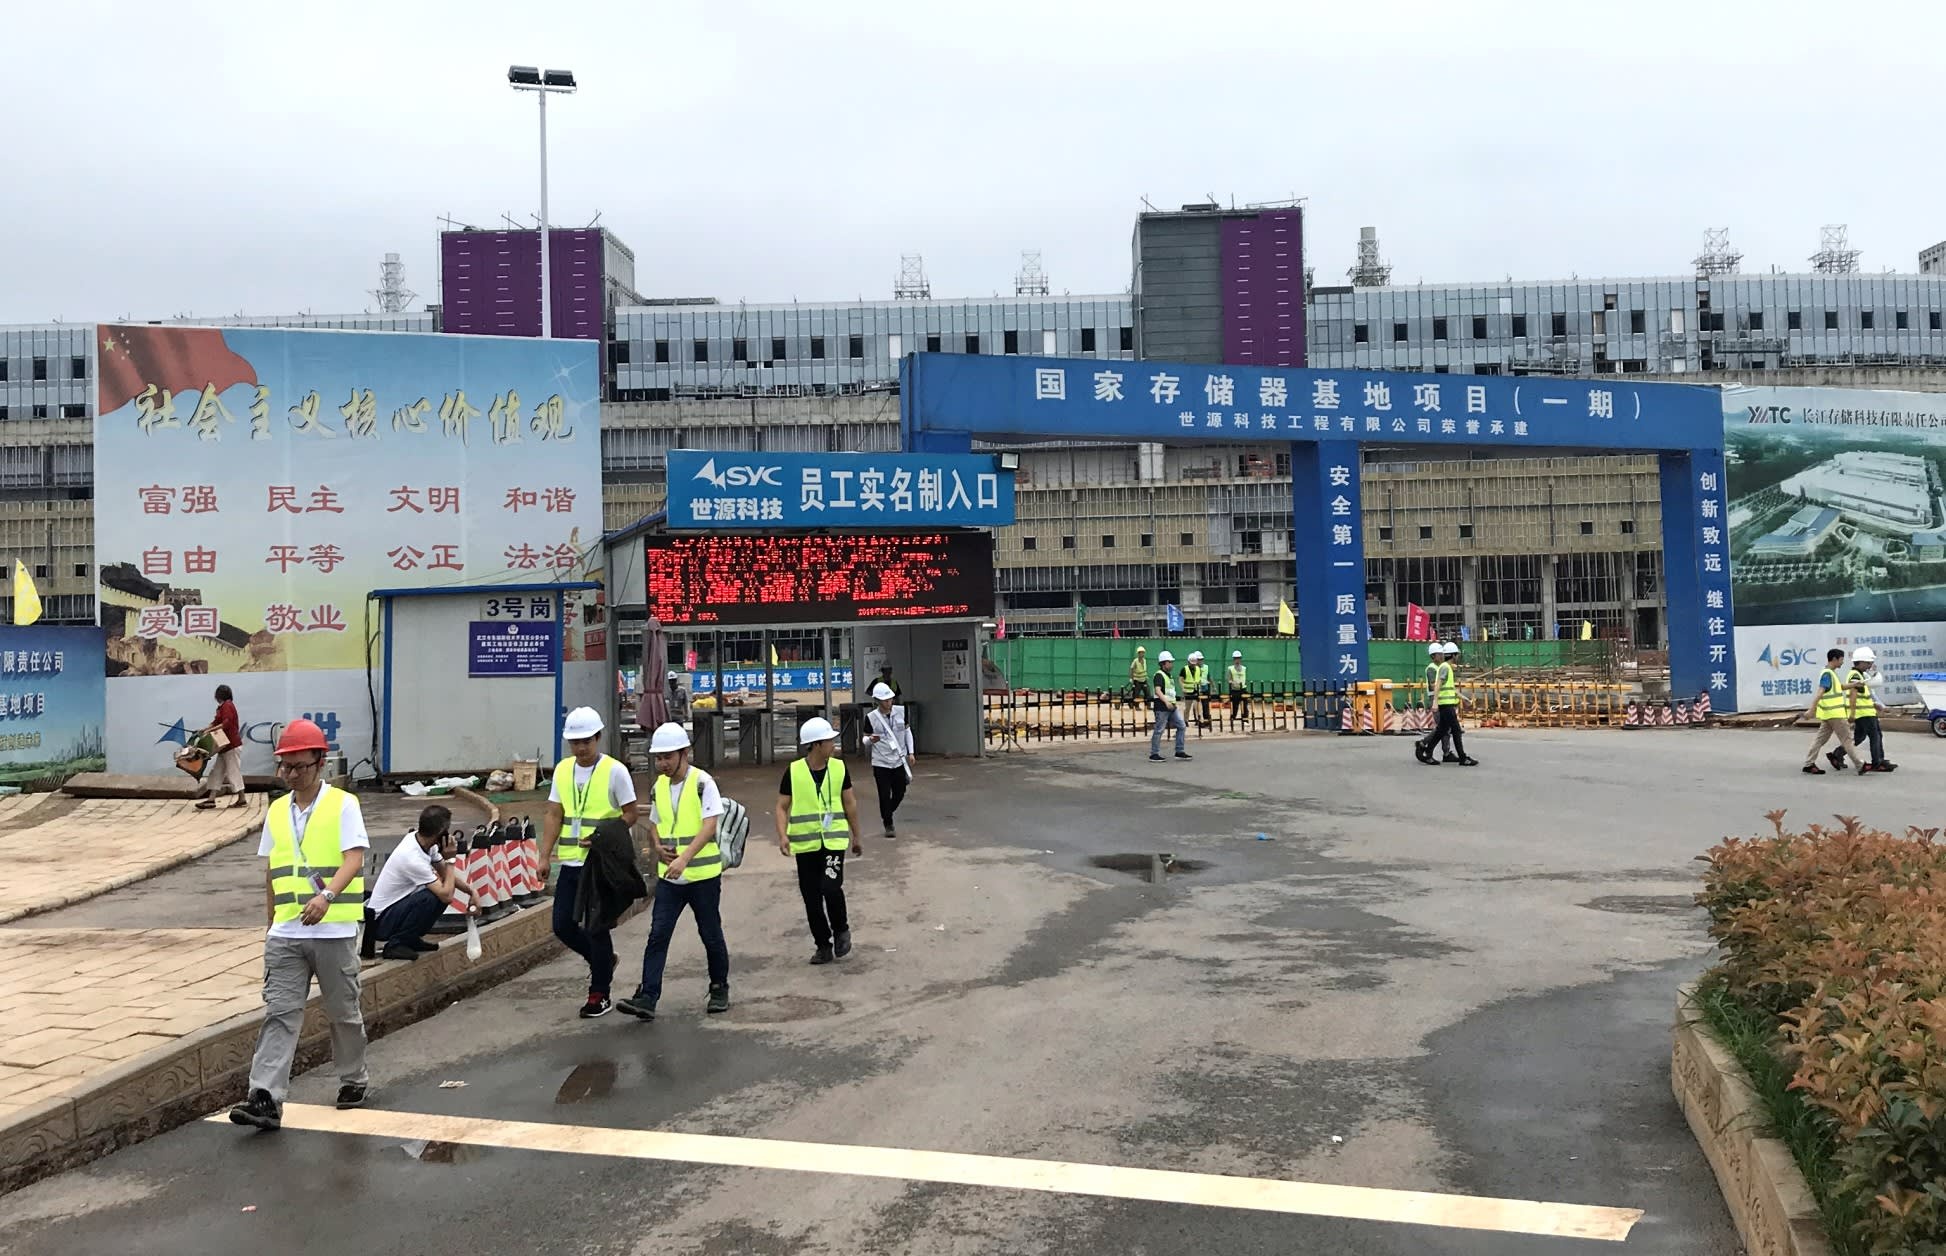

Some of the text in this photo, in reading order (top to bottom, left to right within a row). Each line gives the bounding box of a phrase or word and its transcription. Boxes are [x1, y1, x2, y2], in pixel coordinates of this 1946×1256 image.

[135, 381, 577, 447] 社会主义核心价值观
[1178, 411, 1529, 437] 世源科技工程有限公司荣誉承建
[138, 485, 577, 514] 富强 民主 文明 和谐
[799, 467, 999, 512] 员工实名制入口
[690, 497, 784, 521] 世源科技
[1329, 465, 1355, 568] 安全第一
[142, 543, 577, 574] 自由 平等 公正 法治
[1699, 472, 1729, 692] 创新致远 继往开来
[137, 603, 347, 638] 爱国 敬业
[486, 597, 551, 618] 3号岗
[0, 650, 64, 672] 限责任公司
[1780, 648, 1817, 666] SYC
[1761, 678, 1813, 697] 世源科技
